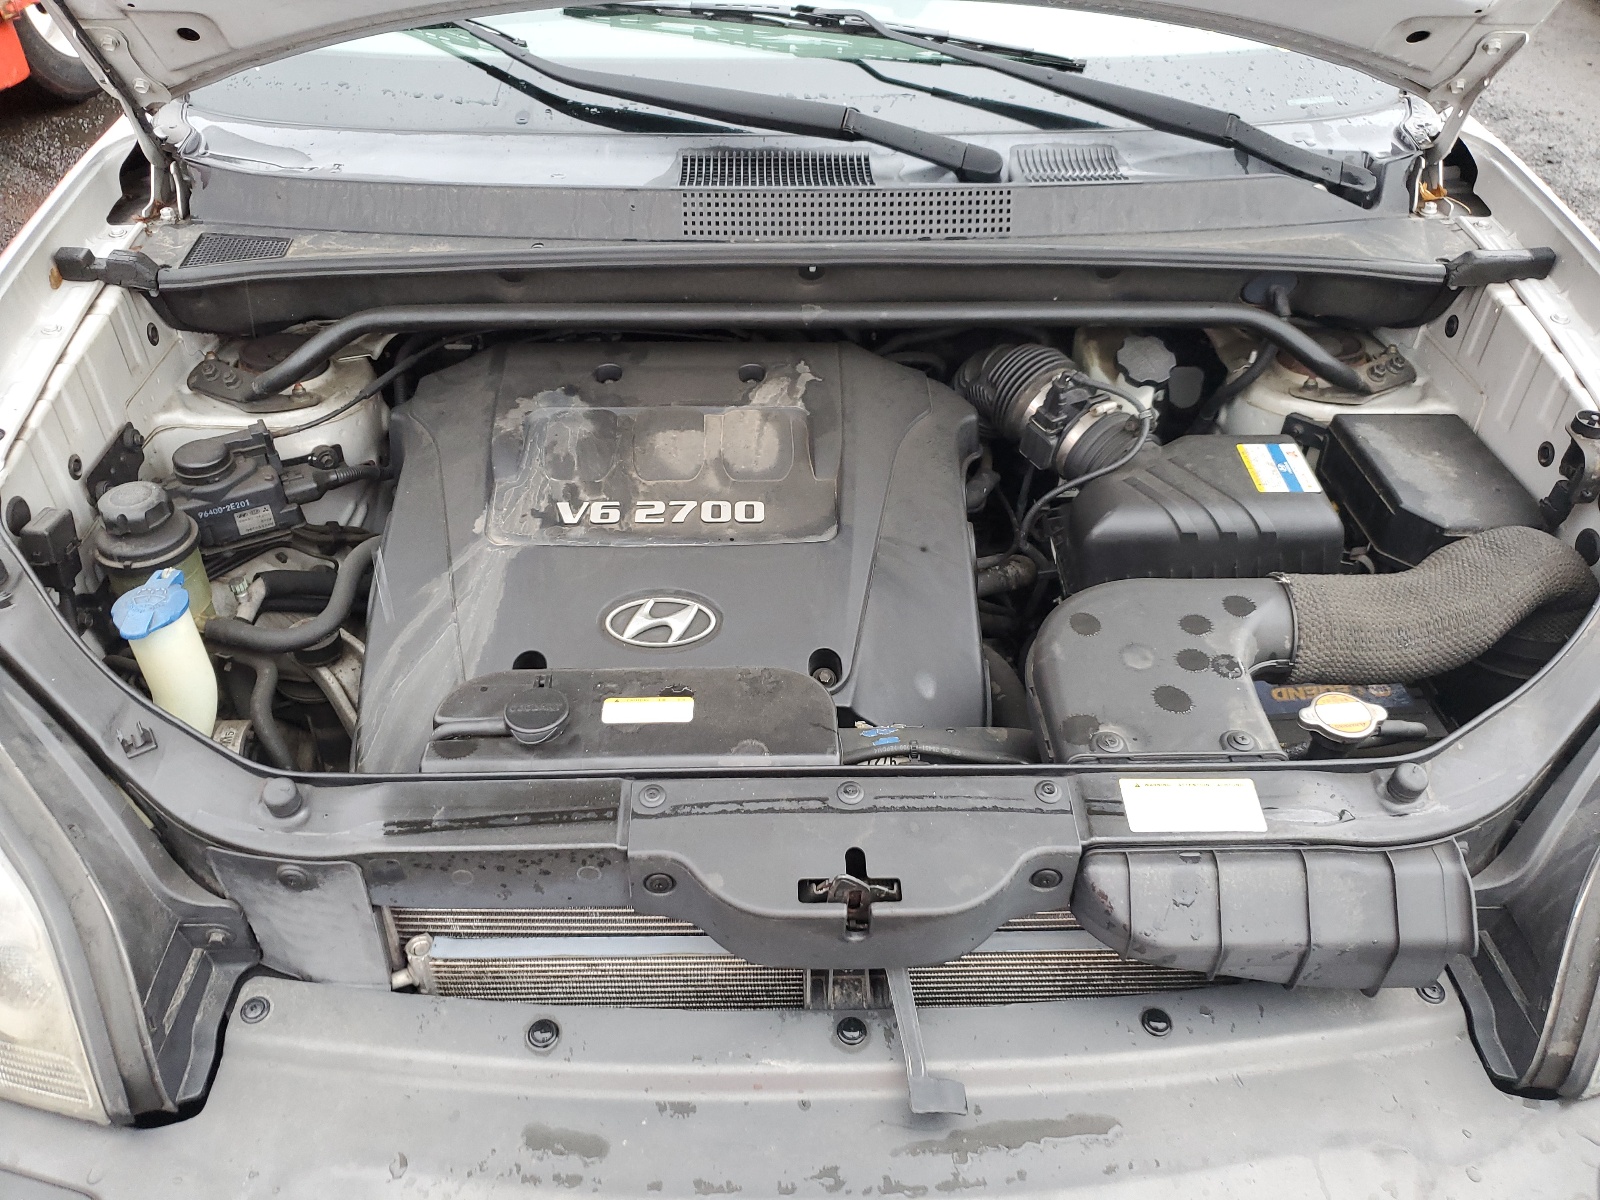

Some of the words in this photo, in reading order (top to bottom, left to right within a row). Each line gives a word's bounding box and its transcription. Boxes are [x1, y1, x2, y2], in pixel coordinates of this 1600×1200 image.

[197, 499, 250, 519] 96400-2E201
[556, 501, 621, 524] V6
[634, 501, 765, 523] 2700
